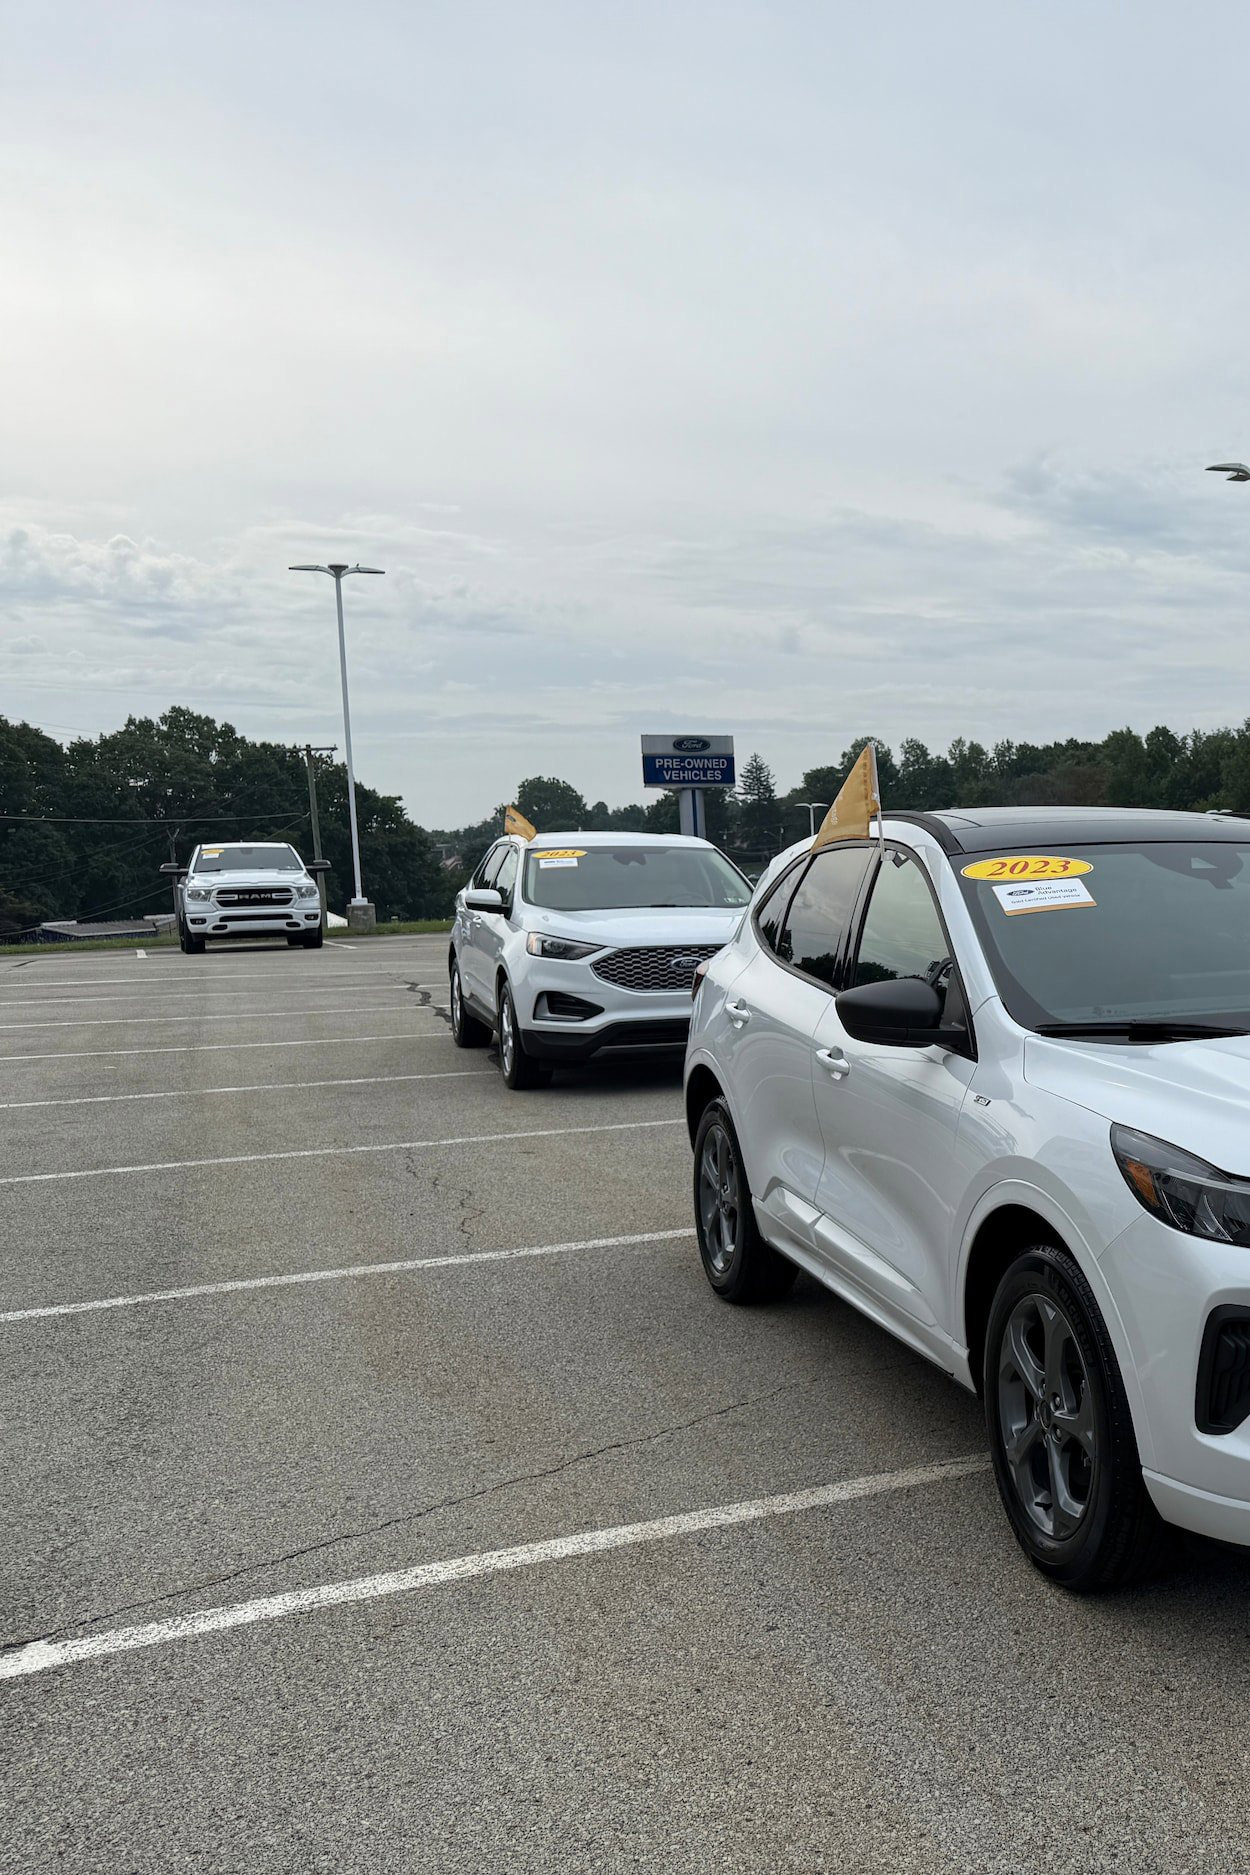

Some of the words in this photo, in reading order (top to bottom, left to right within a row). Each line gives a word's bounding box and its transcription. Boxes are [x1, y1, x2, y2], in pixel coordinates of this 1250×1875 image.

[681, 740, 704, 749] Ford
[655, 758, 727, 769] PRE-OWNED
[663, 770, 722, 781] VEHICLES
[986, 860, 1071, 877] 2023
